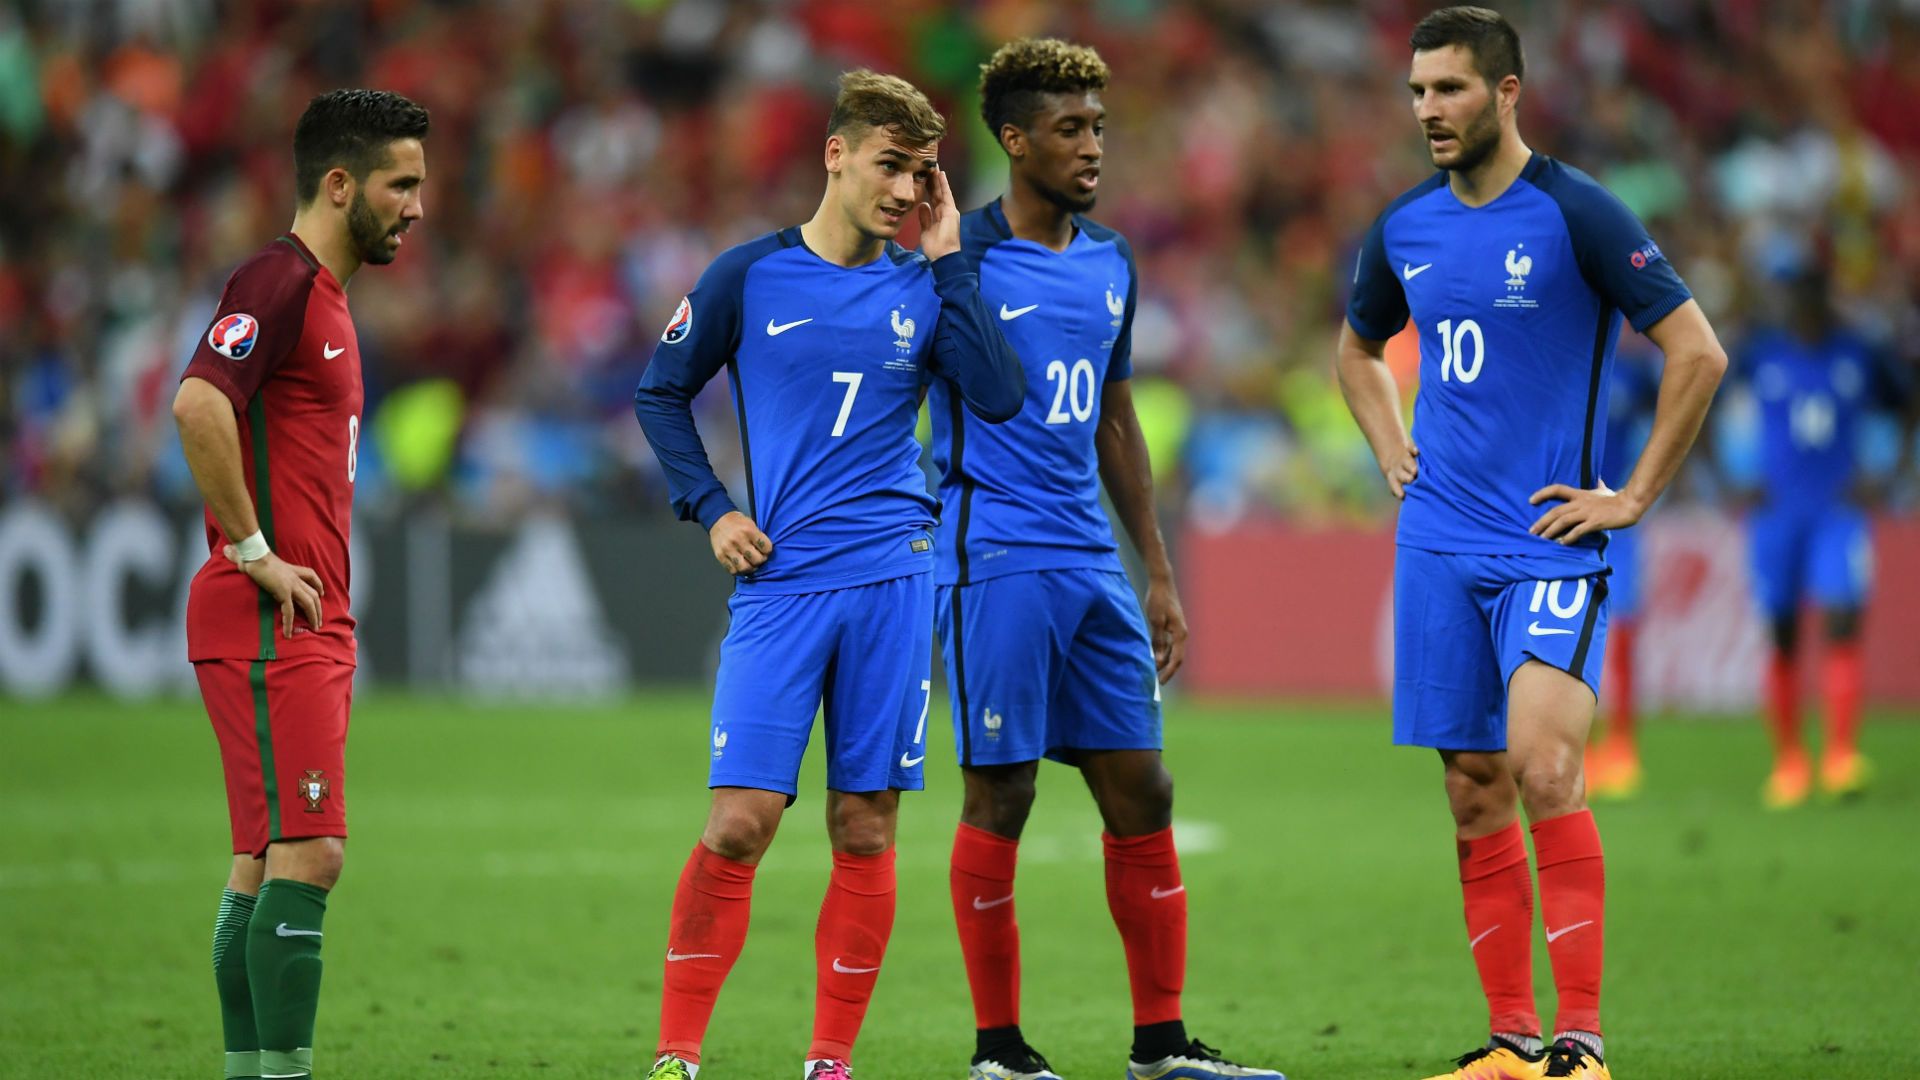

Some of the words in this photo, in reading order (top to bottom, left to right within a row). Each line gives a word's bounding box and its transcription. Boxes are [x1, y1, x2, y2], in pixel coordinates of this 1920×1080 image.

[1436, 319, 1485, 383] 10
[831, 371, 864, 437] 7
[1045, 358, 1095, 424] 20
[347, 414, 359, 483] 8
[1528, 578, 1588, 619] 10
[913, 679, 931, 744] 7
